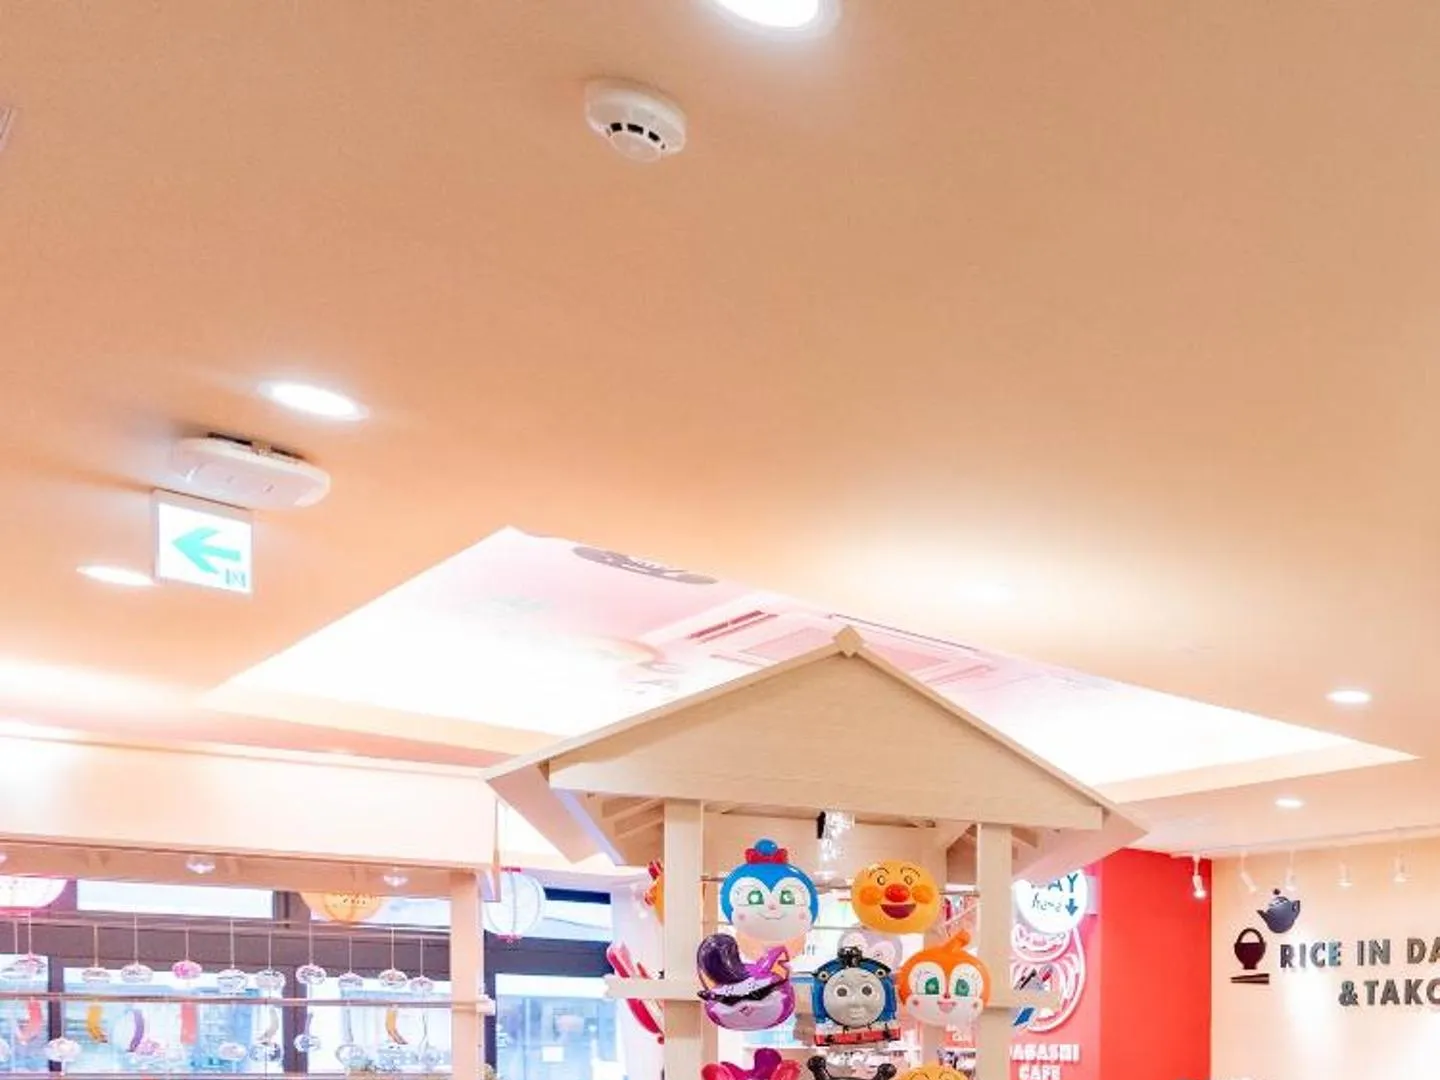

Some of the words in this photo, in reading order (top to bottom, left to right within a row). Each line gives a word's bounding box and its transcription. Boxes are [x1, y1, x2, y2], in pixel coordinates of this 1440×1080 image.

[1279, 941, 1342, 969] RICE
[1356, 938, 1392, 966] IN
[1009, 1043, 1080, 1062] AGASHI
